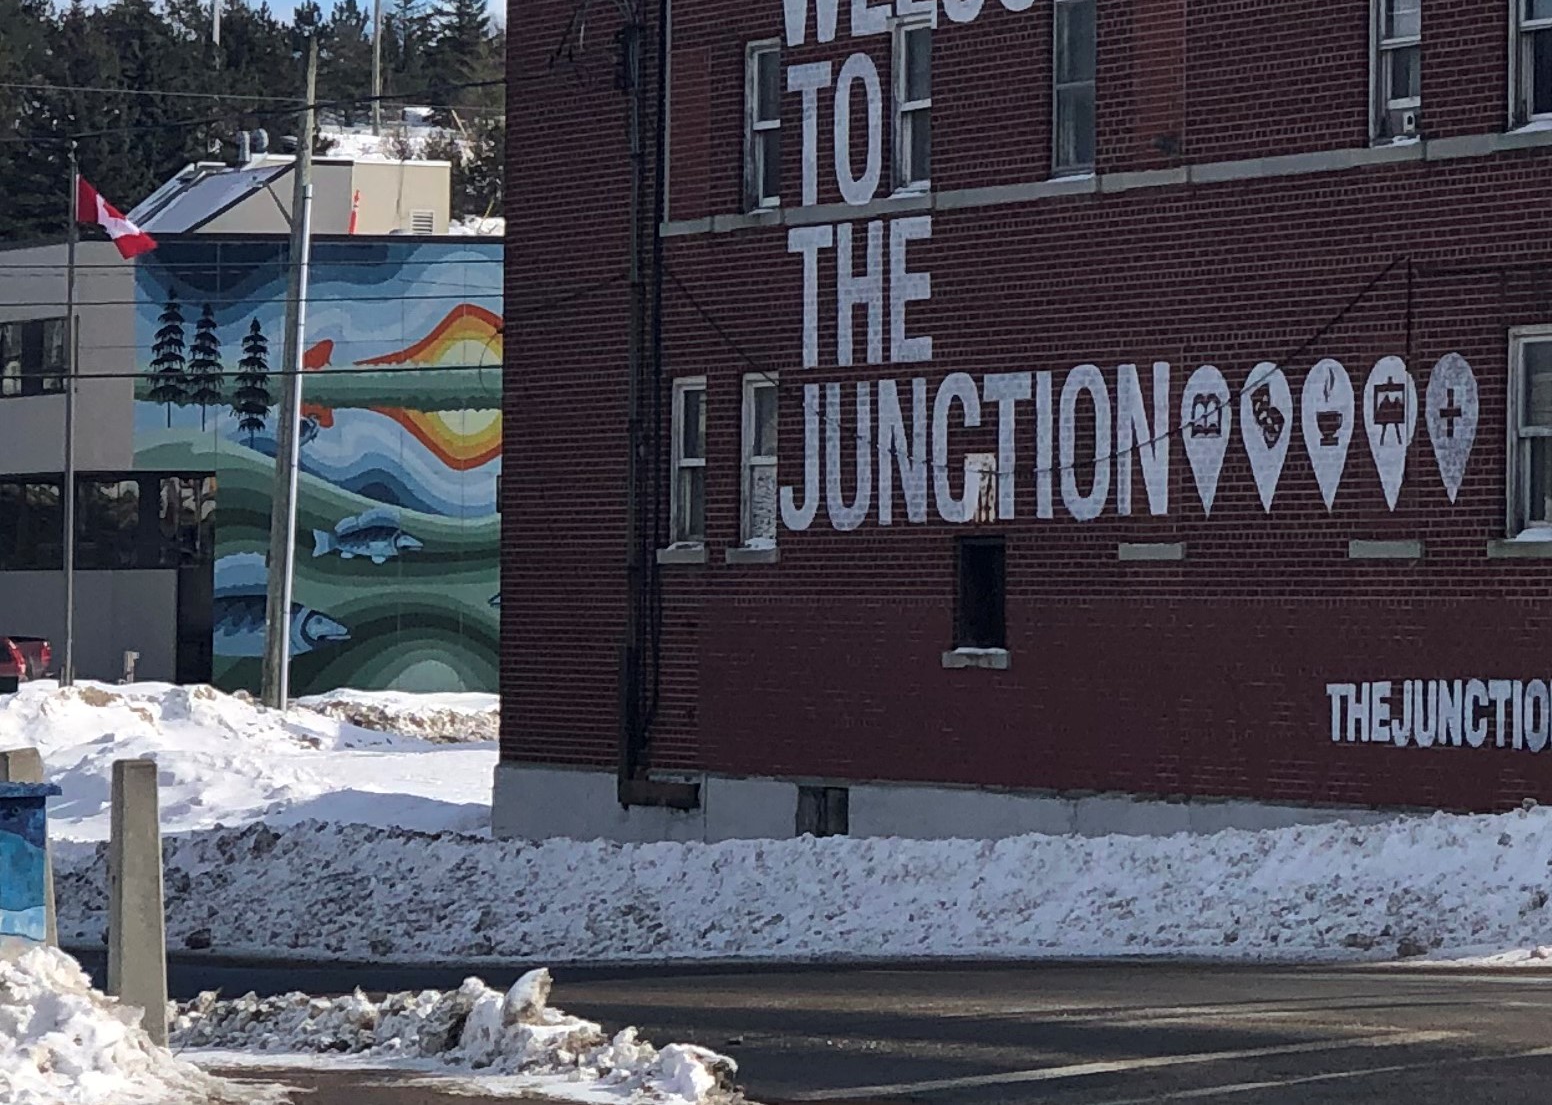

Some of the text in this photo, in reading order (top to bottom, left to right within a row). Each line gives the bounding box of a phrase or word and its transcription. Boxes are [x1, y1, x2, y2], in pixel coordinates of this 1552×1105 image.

[787, 52, 883, 207] TO
[787, 215, 934, 370] THE
[779, 360, 1171, 532] JUNCTION
